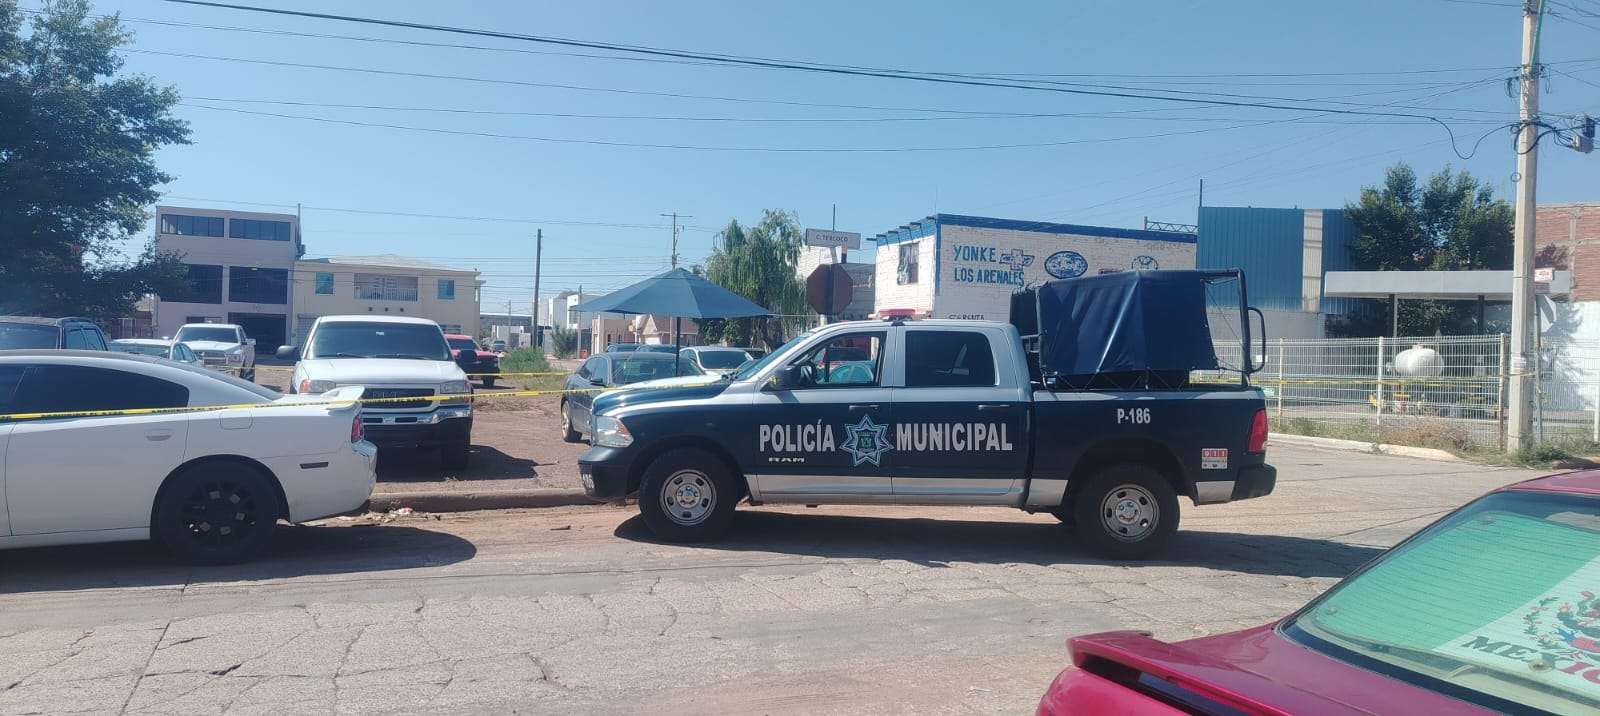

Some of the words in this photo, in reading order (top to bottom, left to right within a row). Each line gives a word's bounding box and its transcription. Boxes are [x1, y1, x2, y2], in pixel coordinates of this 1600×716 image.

[953, 245, 996, 262] YONKE
[954, 267, 974, 283] LOS
[976, 269, 1025, 287] ARENALES
[1117, 407, 1151, 424] P-186
[759, 419, 836, 452] POLICÍA
[896, 423, 1013, 451] MUNICIPAL
